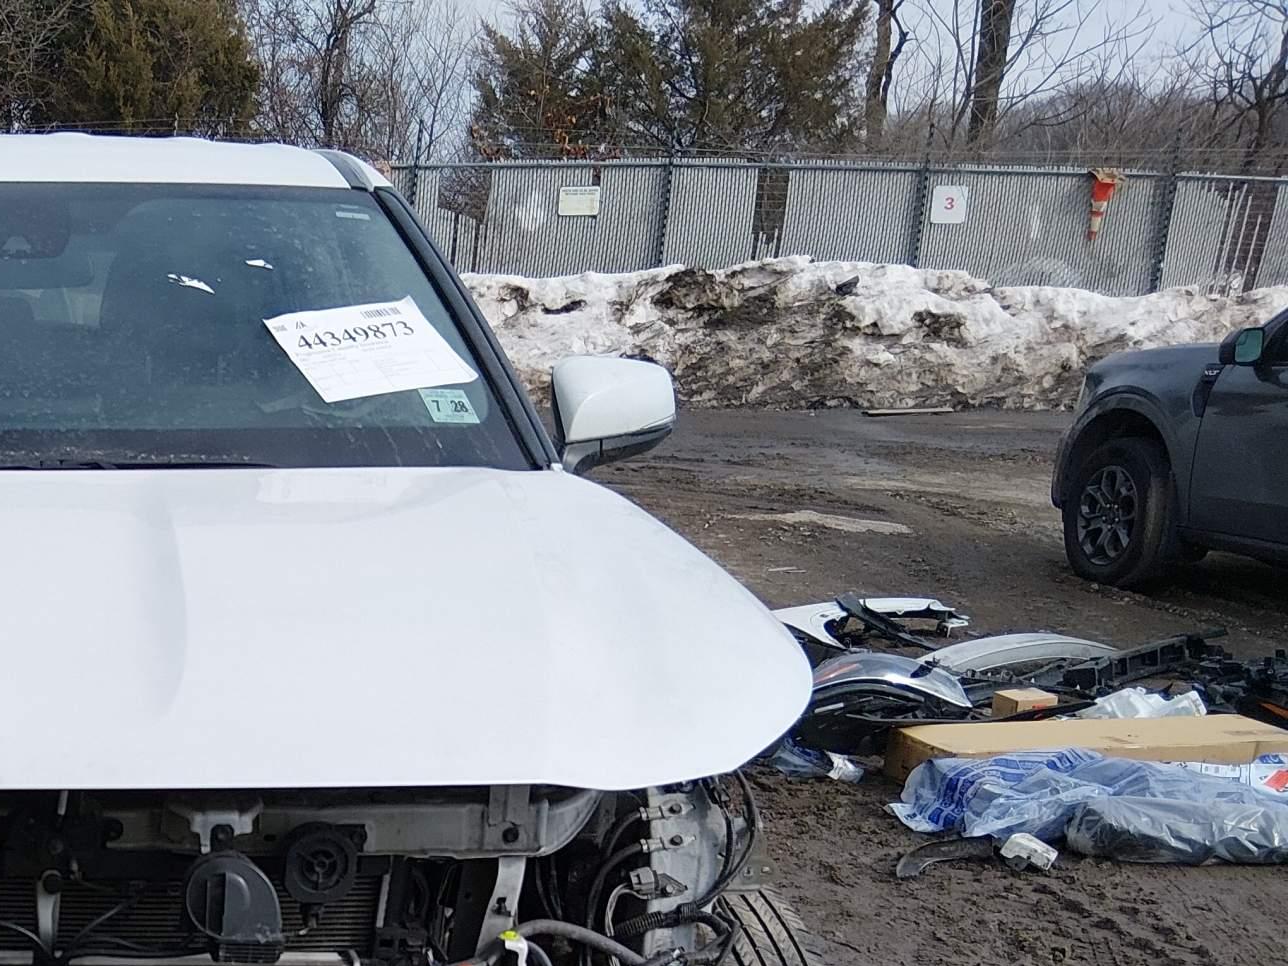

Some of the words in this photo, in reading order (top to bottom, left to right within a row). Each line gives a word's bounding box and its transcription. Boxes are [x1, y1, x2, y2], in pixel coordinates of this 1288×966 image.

[944, 197, 955, 210] 3
[298, 320, 415, 350] 44349873
[431, 399, 441, 412] 7
[450, 400, 469, 413] 28
